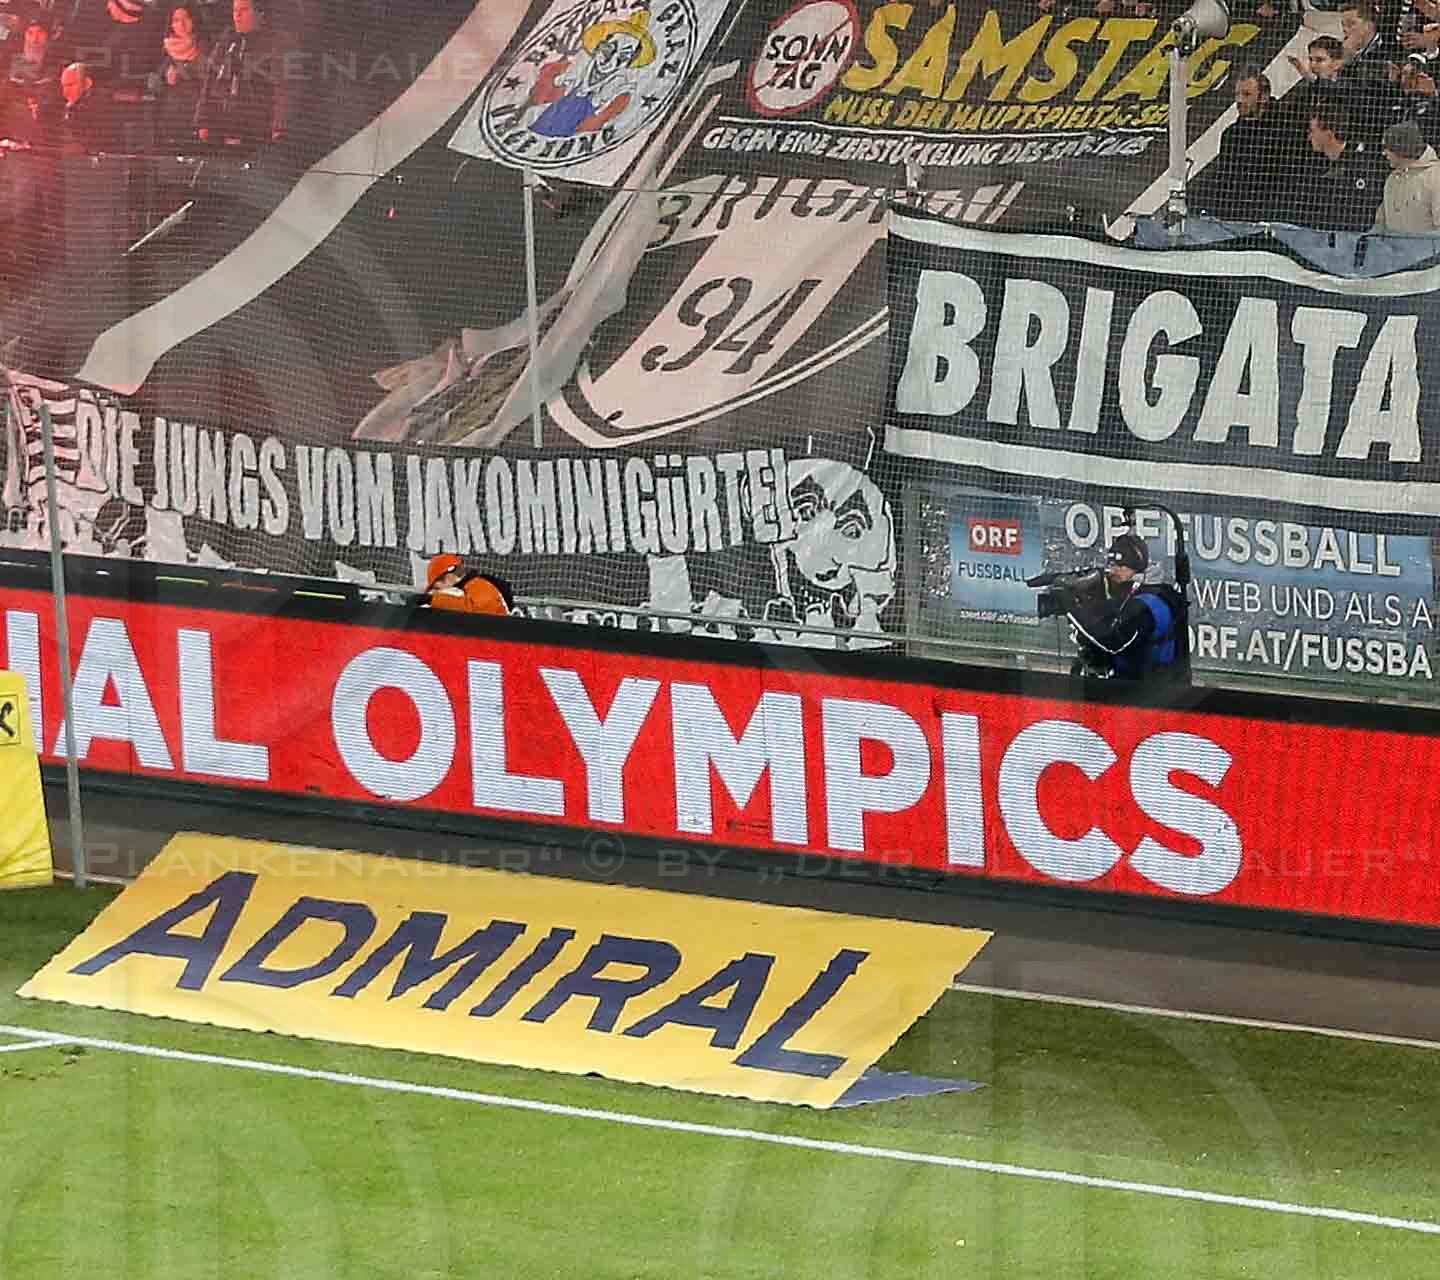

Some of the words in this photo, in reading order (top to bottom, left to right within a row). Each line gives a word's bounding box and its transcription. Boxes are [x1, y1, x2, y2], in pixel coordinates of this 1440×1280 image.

[840, 2, 1261, 104] SAMSTAG
[703, 126, 777, 153] GEGEN
[777, 131, 832, 156] EINE
[998, 138, 1044, 167] DES
[823, 95, 893, 126] MUSS
[893, 99, 947, 129] DER
[641, 275, 822, 376] 94
[894, 268, 1424, 464] BRIGATA
[78, 390, 143, 504] DIE
[152, 416, 289, 538] JUNGS
[296, 443, 398, 548] VOM
[403, 446, 796, 556] JAKOMINIGÜRTEL
[958, 561, 1031, 583] FUSSBALL
[970, 523, 1019, 550] ORF
[1195, 578, 1262, 613] WEB
[1270, 582, 1337, 621] UND
[1343, 588, 1401, 627] ALS
[330, 643, 1248, 901] OLYMPICS
[65, 870, 873, 1082] ADMIRAL
